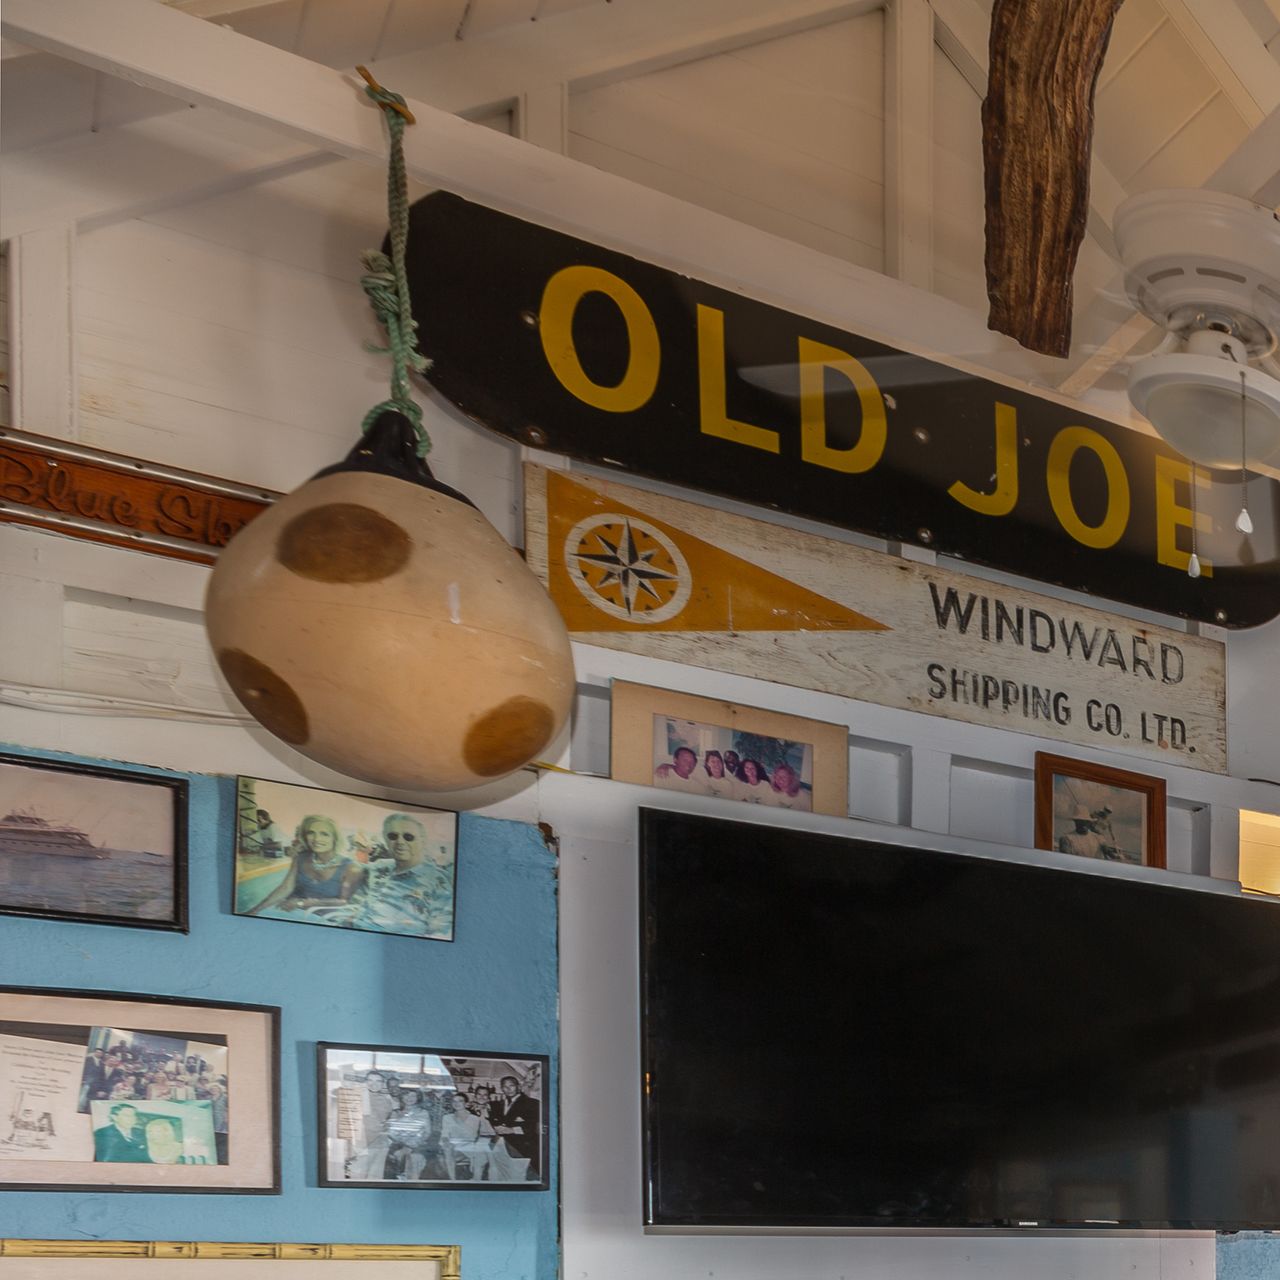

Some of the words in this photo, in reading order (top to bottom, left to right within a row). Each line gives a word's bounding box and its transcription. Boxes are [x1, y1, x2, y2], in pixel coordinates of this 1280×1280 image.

[539, 265, 888, 474] OLD
[947, 401, 1214, 579] JOE
[928, 581, 1184, 685] WINDWARD
[926, 663, 1071, 726] SHIPPING
[1086, 698, 1131, 739] CO.
[1140, 711, 1196, 753] LTD.
